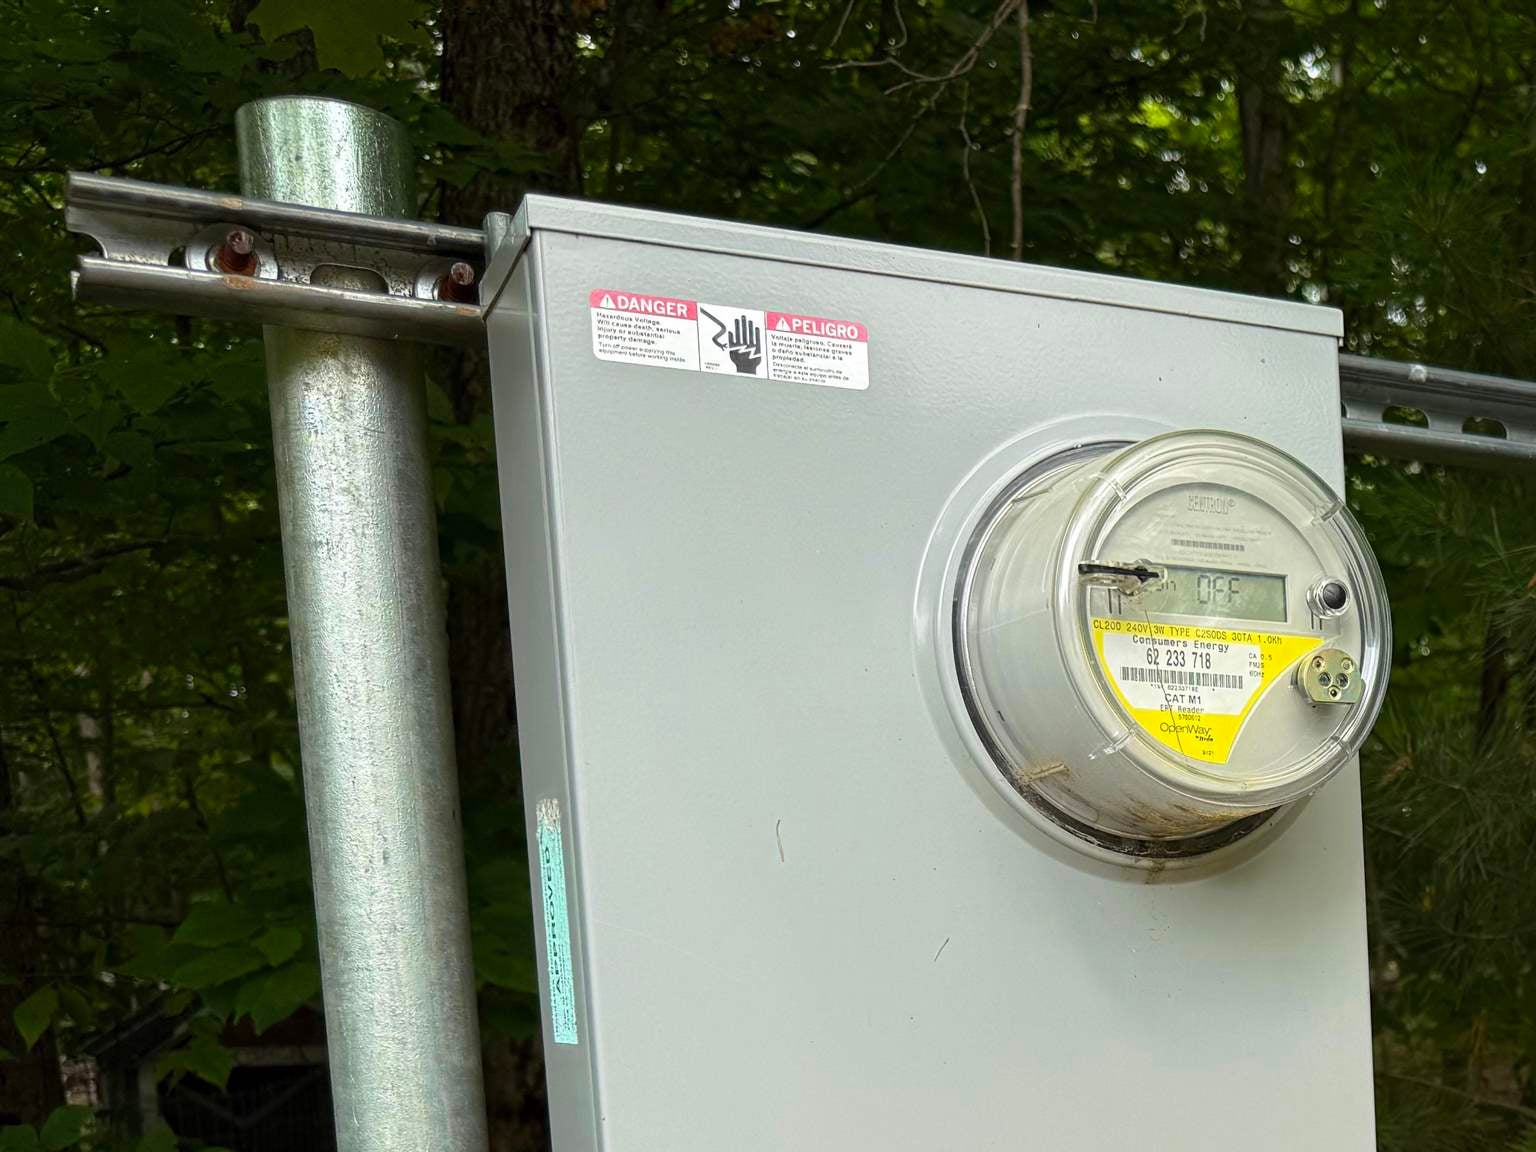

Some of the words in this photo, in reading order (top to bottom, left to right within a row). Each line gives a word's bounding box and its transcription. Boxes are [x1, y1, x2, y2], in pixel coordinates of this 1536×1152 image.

[617, 296, 687, 317] DANGER
[792, 318, 858, 339] PELIGRO
[1197, 574, 1240, 604] OFF
[1093, 619, 1121, 631] CL200
[1127, 622, 1148, 633] 240V
[1154, 625, 1165, 635] 3W
[1170, 627, 1190, 637] TYPE
[1132, 635, 1187, 647] Consumers
[1194, 640, 1229, 651] Energy
[1147, 651, 1159, 665] 62
[1166, 651, 1185, 667] 233
[1192, 652, 1211, 669] 718
[1165, 693, 1185, 704] CAT
[1188, 695, 1202, 705] M1
[1160, 722, 1212, 736] OpenWay
[544, 846, 562, 994] APPROVED
